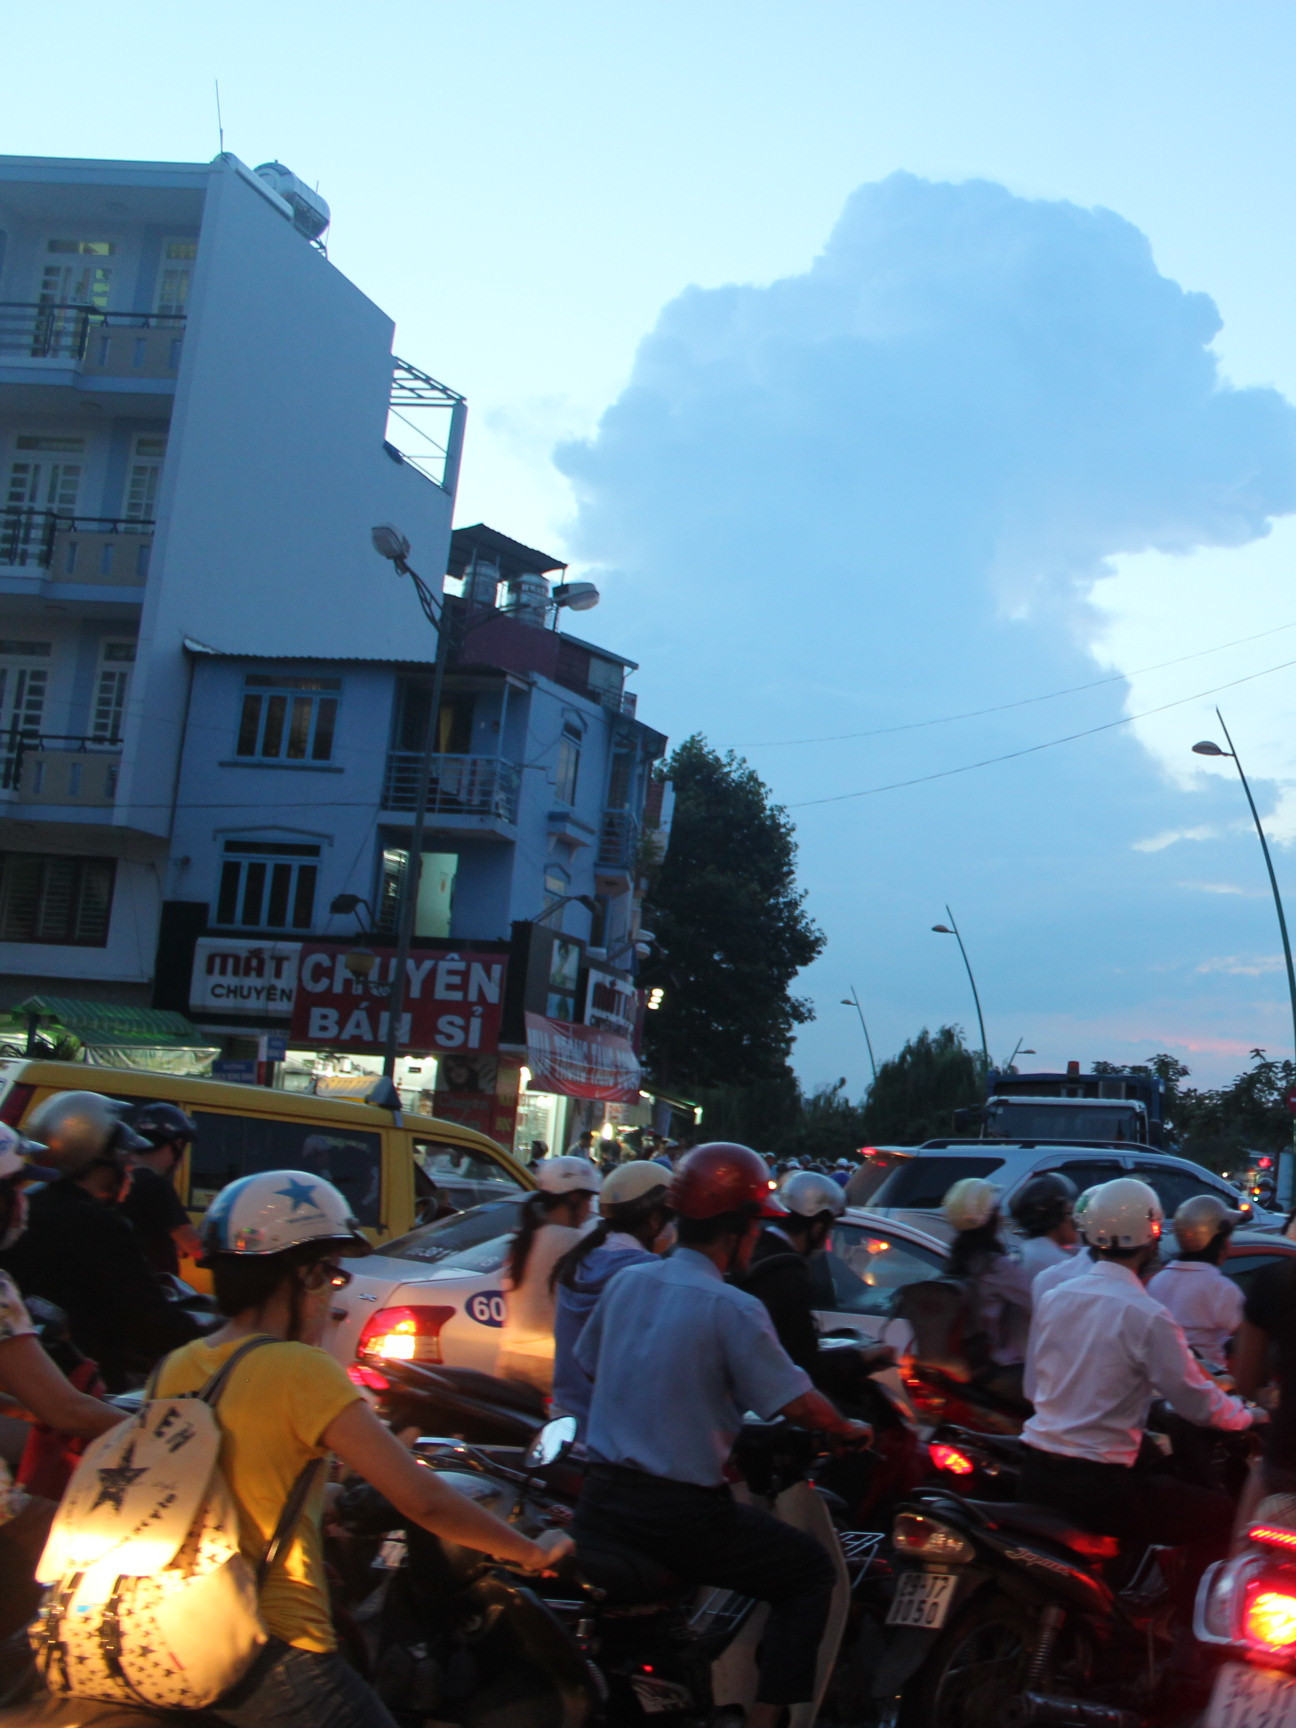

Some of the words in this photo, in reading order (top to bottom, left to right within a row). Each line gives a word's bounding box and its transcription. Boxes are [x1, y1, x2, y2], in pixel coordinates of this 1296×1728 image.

[210, 983, 293, 1002] CHUYÊN
[301, 952, 503, 1004] CHUYÊN
[308, 1001, 412, 1045] BÁN
[433, 1007, 485, 1049] SỈ
[472, 1296, 506, 1322] 60
